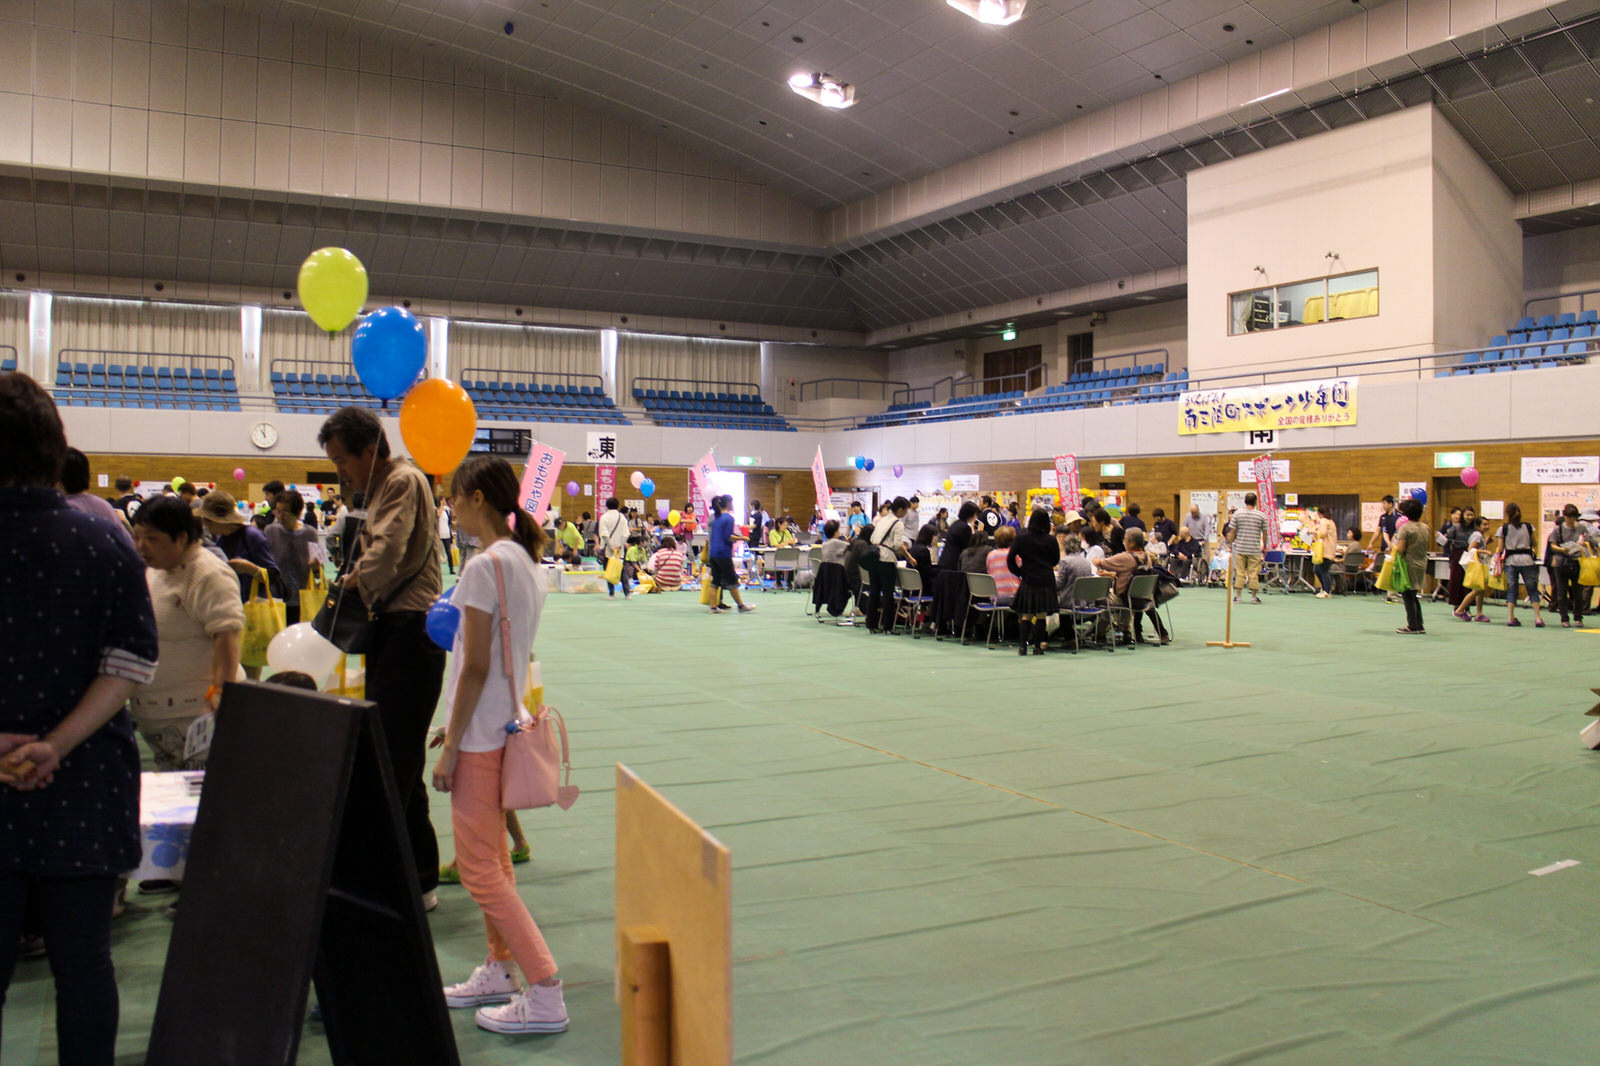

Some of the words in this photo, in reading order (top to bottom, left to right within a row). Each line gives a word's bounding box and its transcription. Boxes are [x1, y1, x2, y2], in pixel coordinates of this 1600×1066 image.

[1277, 412, 1350, 427] 全国の皆様ありがとう
[599, 437, 616, 459] 東
